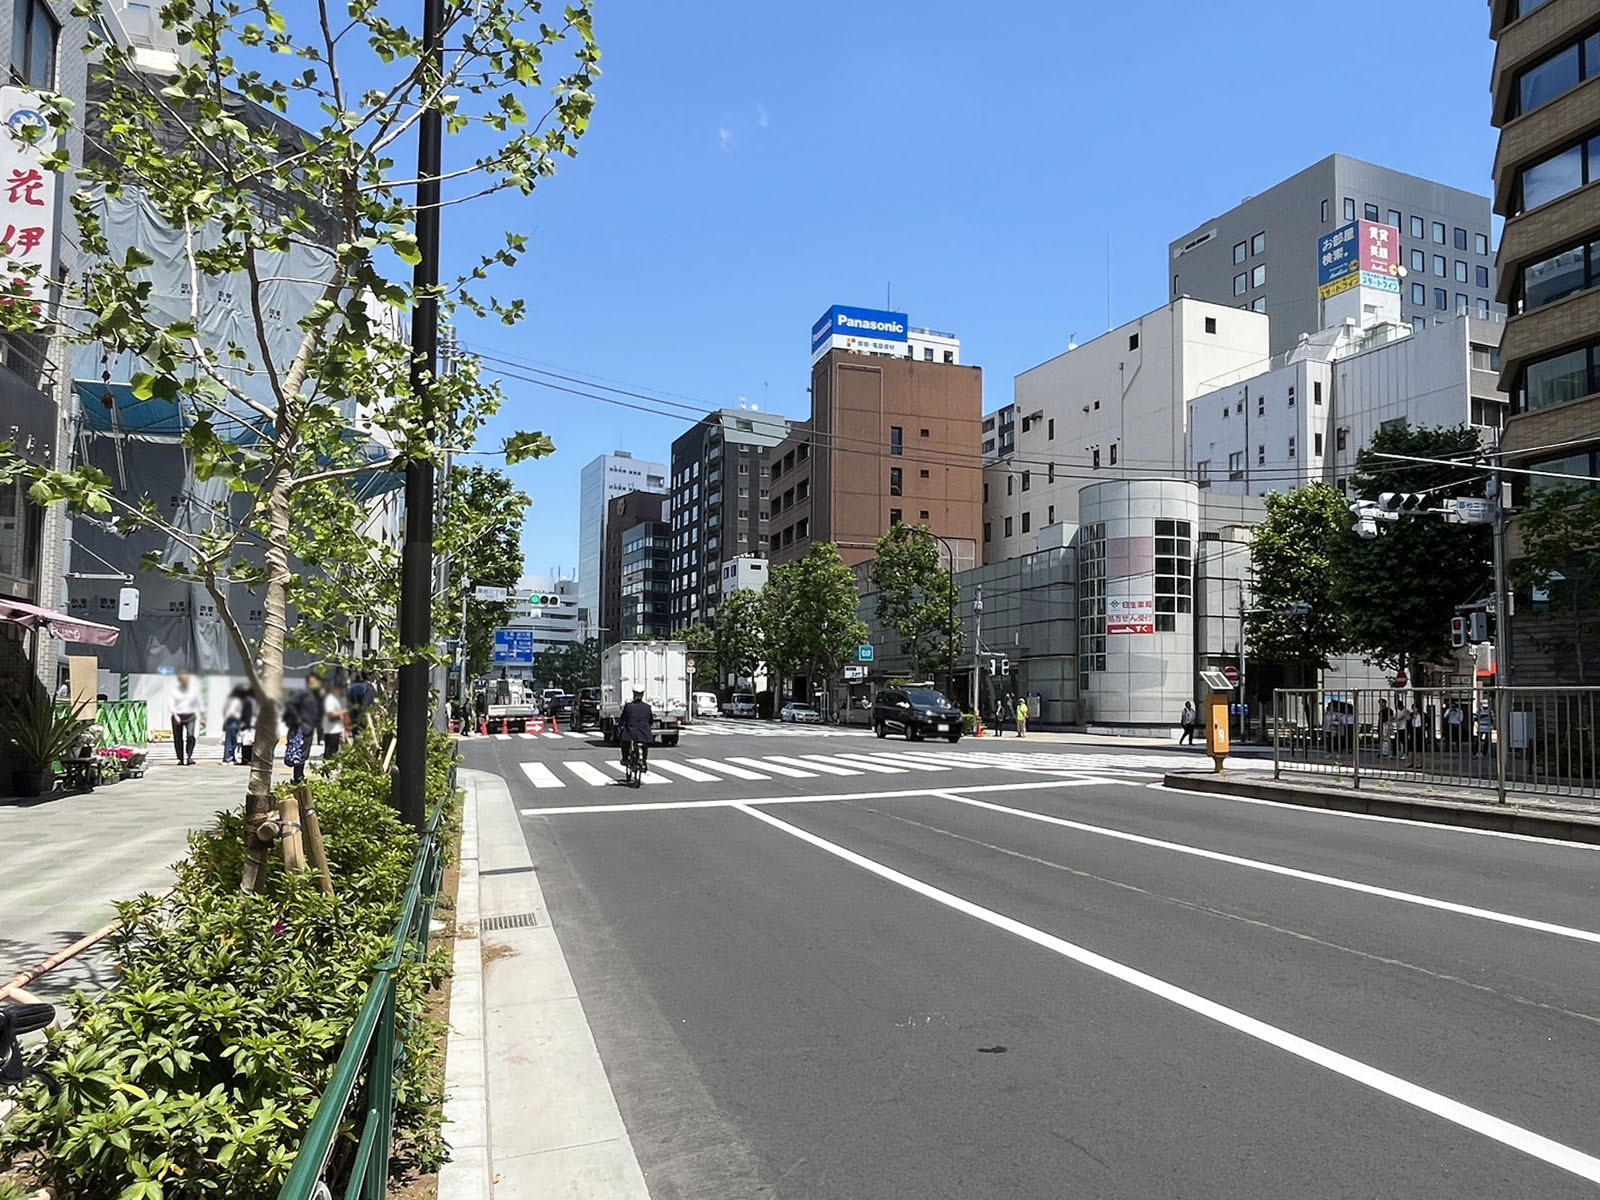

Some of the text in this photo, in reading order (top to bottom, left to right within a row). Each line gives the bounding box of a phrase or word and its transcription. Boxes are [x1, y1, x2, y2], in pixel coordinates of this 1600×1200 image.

[1322, 227, 1354, 252] お部屋
[1362, 277, 1398, 290] スタートライン
[837, 314, 904, 333] Panasonic
